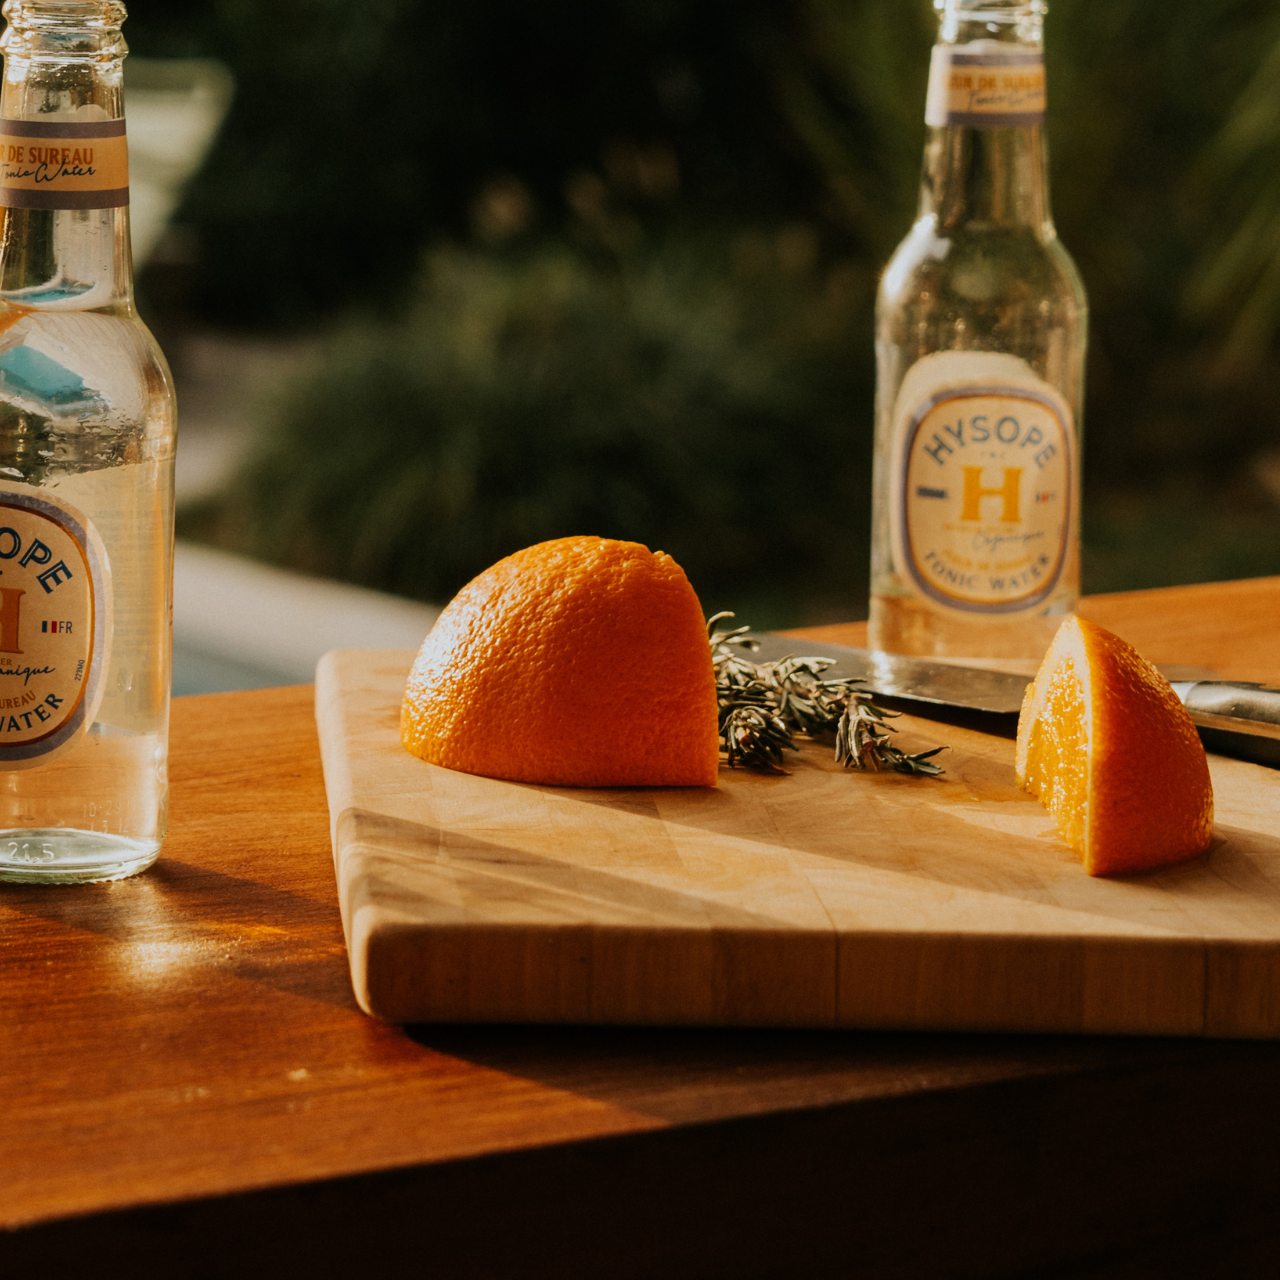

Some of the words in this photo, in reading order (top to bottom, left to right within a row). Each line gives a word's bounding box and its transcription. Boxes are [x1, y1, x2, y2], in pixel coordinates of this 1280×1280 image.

[0, 163, 35, 181] Tonic
[34, 158, 96, 183] Water
[8, 145, 24, 163] DE
[28, 147, 94, 165] SUREAU
[924, 415, 1056, 469] HYSOPE
[960, 466, 1023, 523] H
[924, 551, 977, 588] TONIC
[989, 552, 1050, 590] WATER
[58, 621, 73, 634] FR
